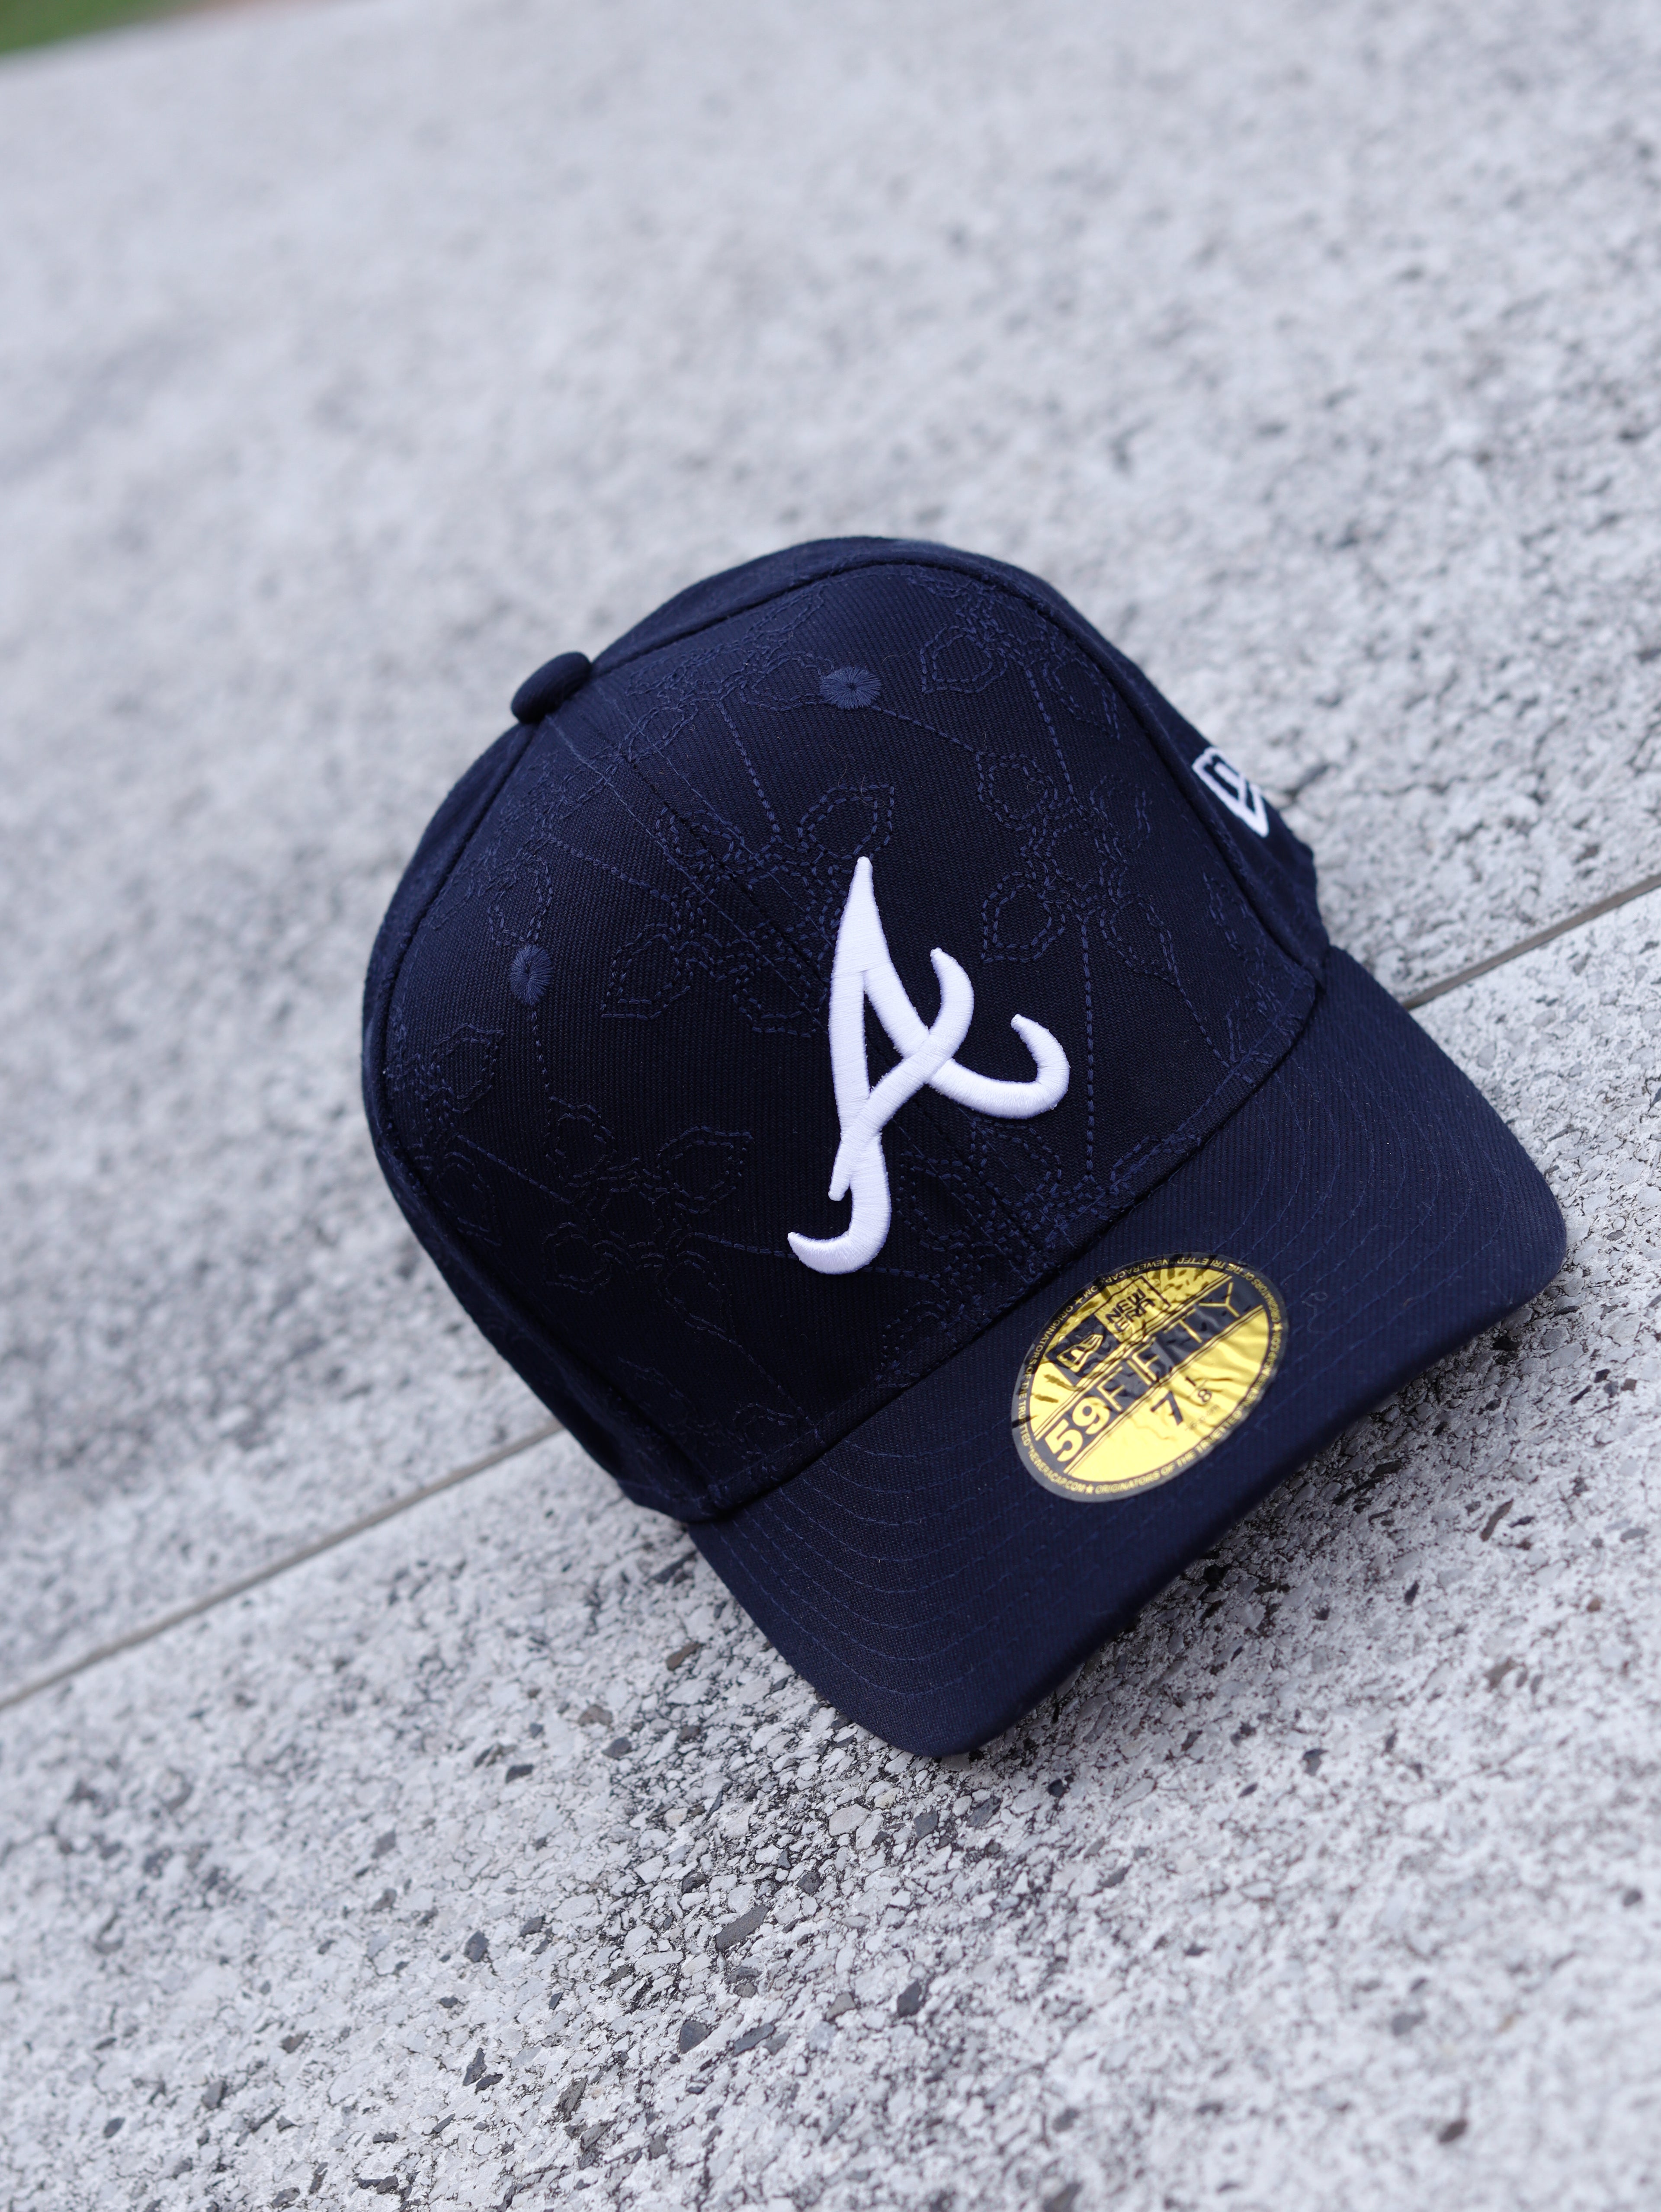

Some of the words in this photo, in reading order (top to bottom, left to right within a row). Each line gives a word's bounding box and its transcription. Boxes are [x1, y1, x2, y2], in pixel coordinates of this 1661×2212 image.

[787, 856, 1070, 1274] A
[1225, 1263, 1244, 1275] THE
[1243, 1271, 1255, 1281] OF
[1106, 1288, 1146, 1323] NEW
[1114, 1298, 1156, 1332] ERA
[1251, 1277, 1281, 1323] ORIGINATORS
[1029, 1305, 1073, 1365] ORIGINATORS
[1018, 1380, 1030, 1399] THE
[1024, 1366, 1033, 1379] OF
[1045, 1282, 1240, 1462] 59FIFTY
[1150, 1390, 1183, 1426] 7
[1095, 1470, 1161, 1495] ORIGINATORS
[1161, 1462, 1175, 1476] OF
[1177, 1450, 1197, 1467] THE
